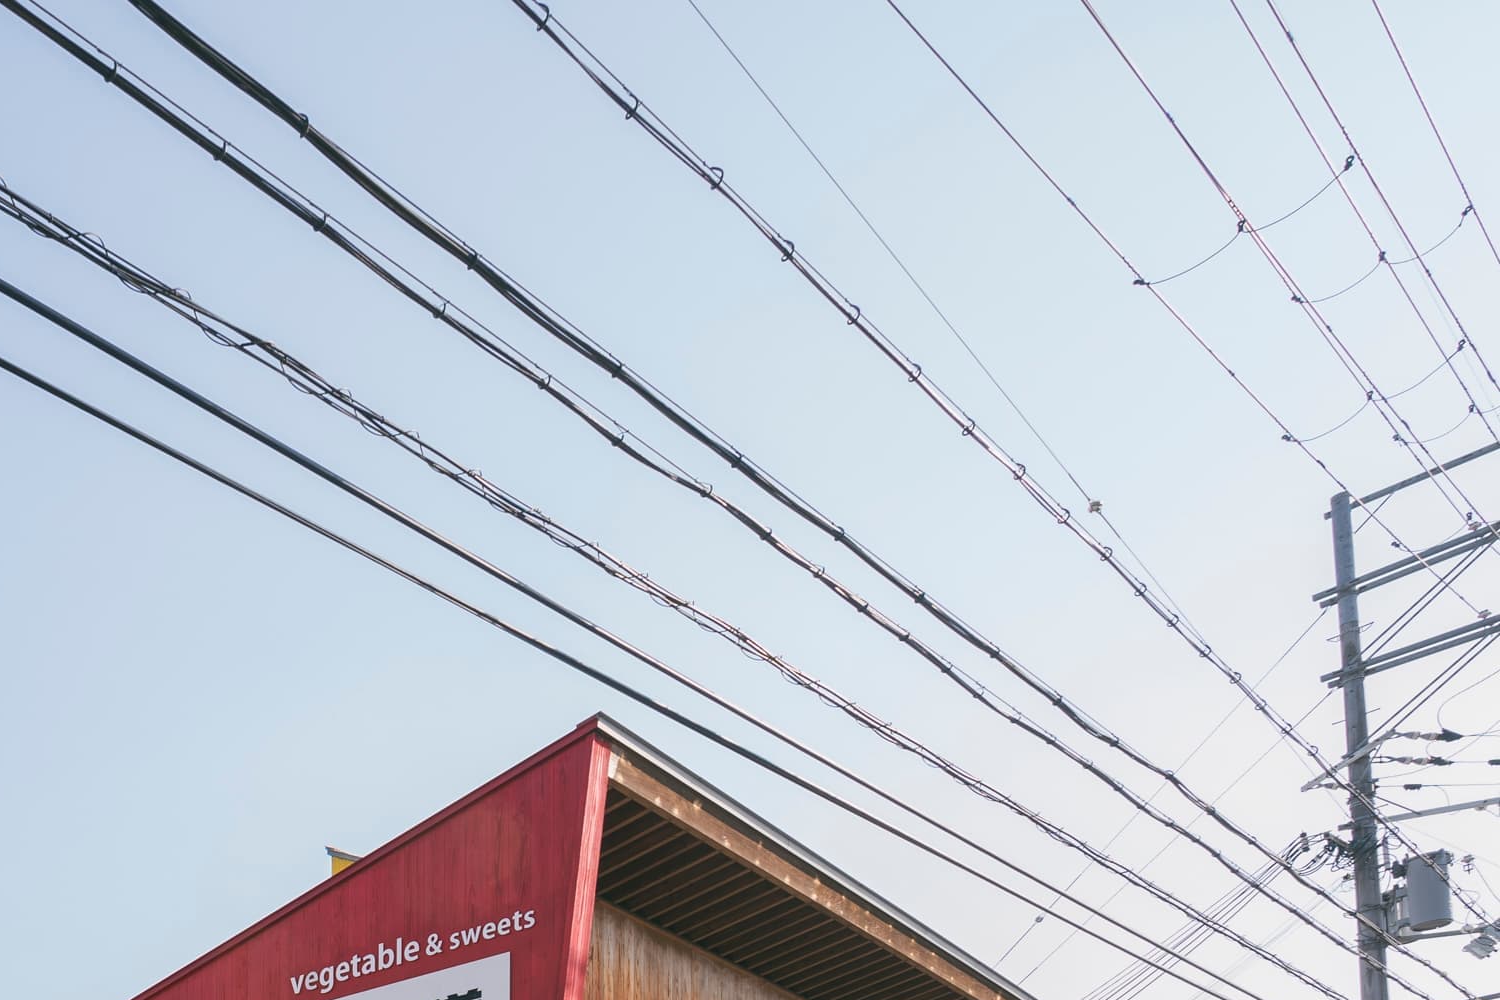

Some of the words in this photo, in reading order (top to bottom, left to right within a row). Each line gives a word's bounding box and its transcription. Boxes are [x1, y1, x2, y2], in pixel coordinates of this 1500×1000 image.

[290, 937, 421, 995] vegetable
[425, 932, 443, 957] &
[449, 908, 536, 951] sweets
